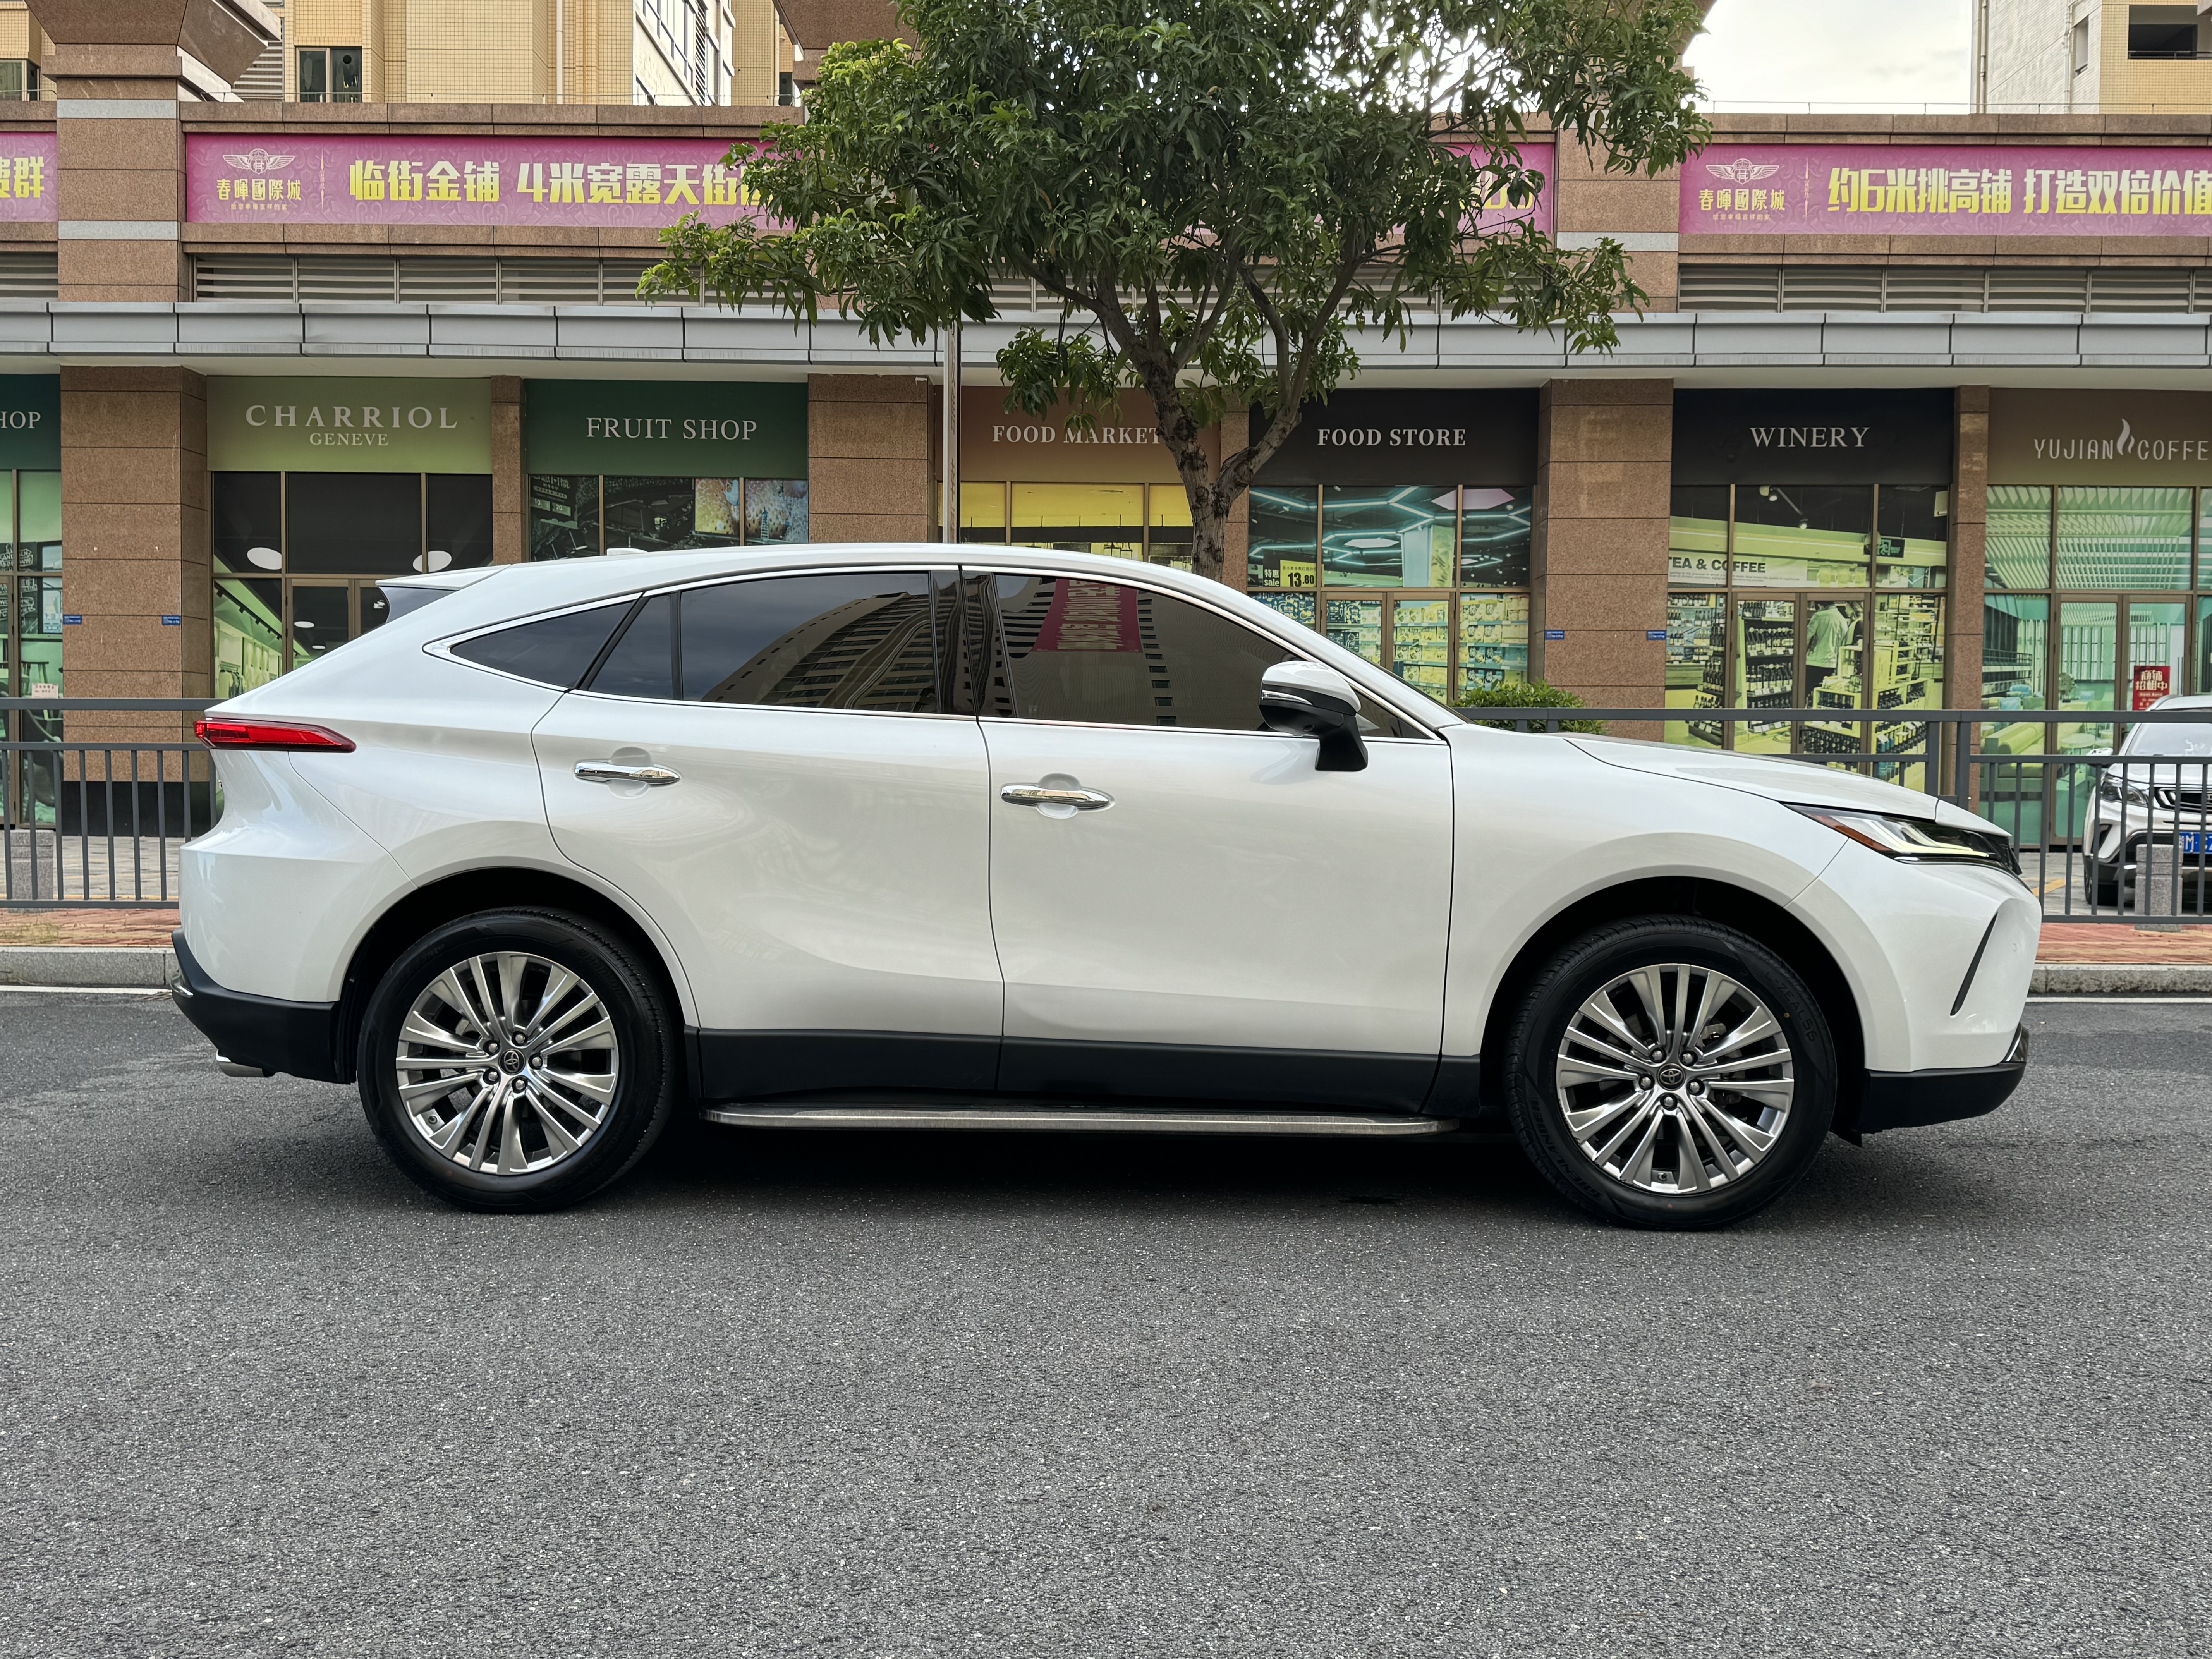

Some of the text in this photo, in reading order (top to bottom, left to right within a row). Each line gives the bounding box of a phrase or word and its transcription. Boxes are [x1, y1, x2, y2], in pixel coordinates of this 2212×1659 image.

[349, 160, 499, 202] 临街金铺
[1828, 167, 2212, 215] 约6米挑高铺 打造双倍价值
[246, 405, 458, 428] CHARRIOL
[586, 417, 757, 440] FRUIT SHOP
[992, 425, 1162, 444] FOOD MARKET
[1317, 428, 1466, 446] FOOD STORE
[1750, 427, 1870, 447] WINERY
[309, 433, 389, 446] GENEVE
[2034, 438, 2114, 460] YUJIAN
[1696, 558, 1707, 570] &
[1264, 579, 1279, 587] sale
[2136, 680, 2168, 691] 招租中
